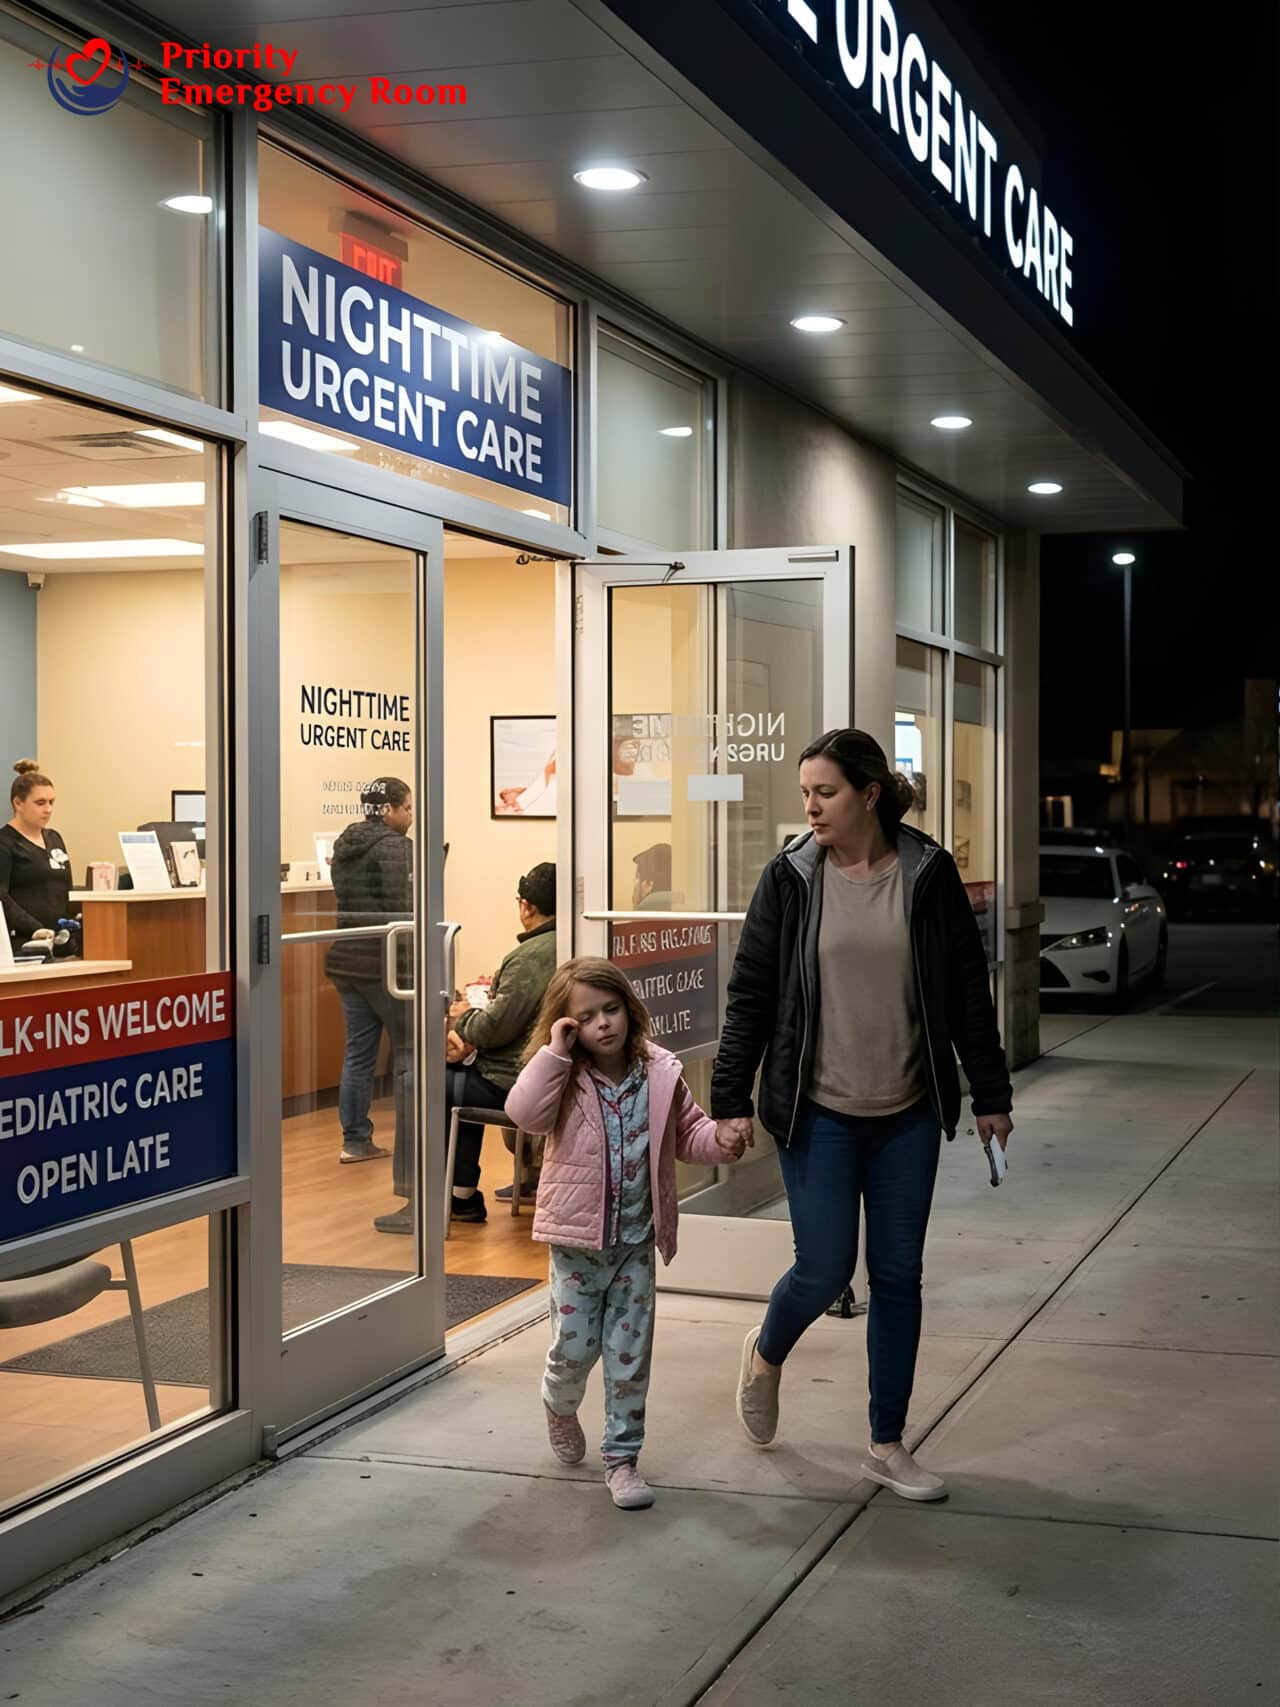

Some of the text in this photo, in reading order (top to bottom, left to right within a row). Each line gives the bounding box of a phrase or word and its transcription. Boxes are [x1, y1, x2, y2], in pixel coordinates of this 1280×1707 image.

[836, 0, 1073, 327] URGENT CARE
[282, 254, 542, 424] NIGHTTIME
[282, 340, 543, 483] URGENT CARE
[301, 685, 410, 722] NIGHTTIME
[301, 723, 410, 752] URGENT CARE
[98, 989, 225, 1040] WELCOME
[0, 1063, 203, 1140] EDIATRIC CARE
[17, 1132, 170, 1204] OPEN LATE
